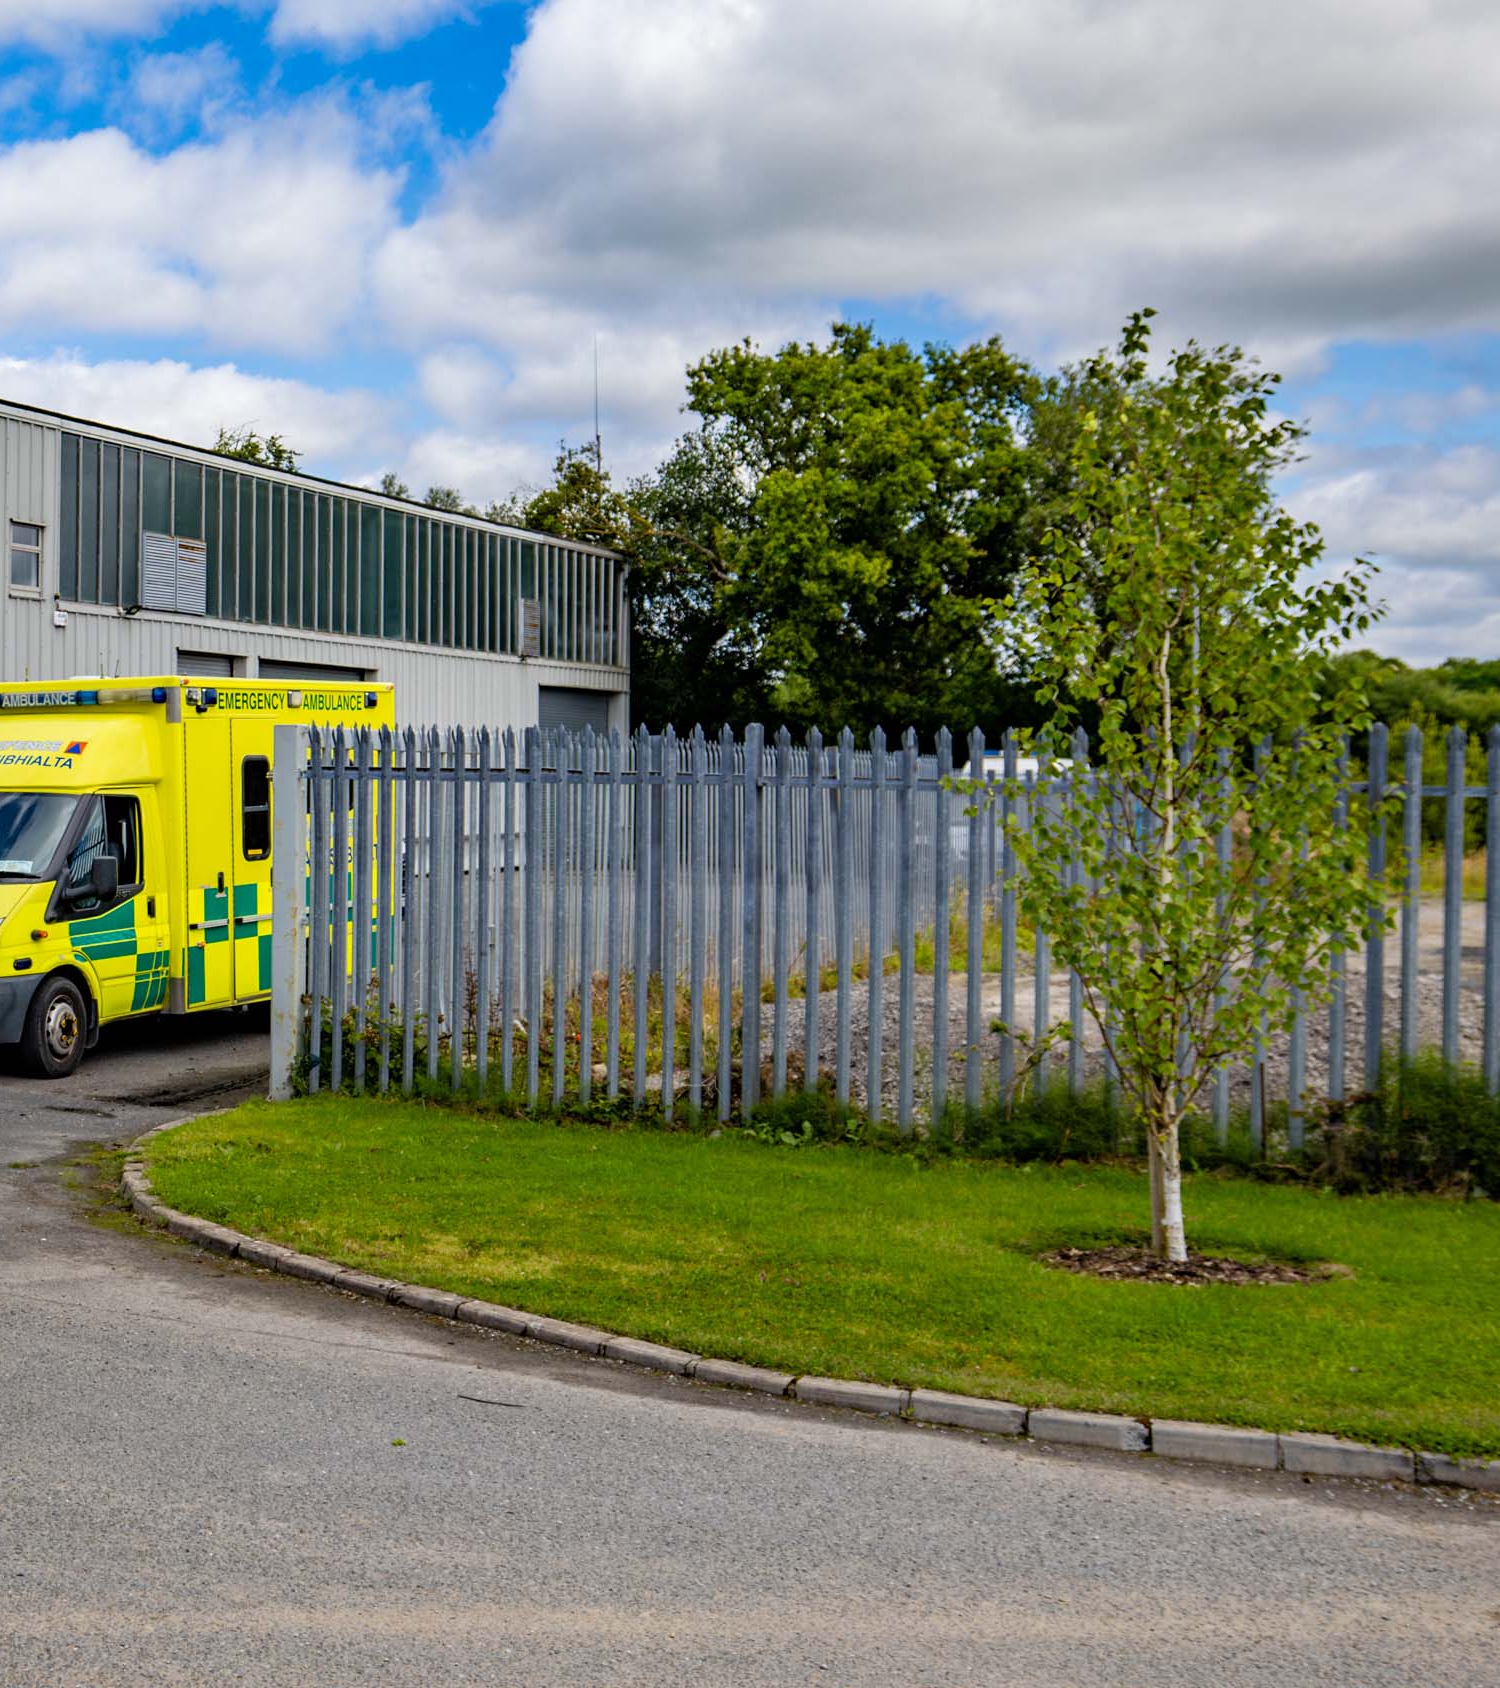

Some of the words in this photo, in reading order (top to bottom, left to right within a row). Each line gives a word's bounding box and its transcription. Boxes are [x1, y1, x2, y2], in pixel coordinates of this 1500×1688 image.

[1, 692, 76, 708] AMBULANCE
[218, 692, 285, 710] EMERGENCY
[302, 693, 362, 711] AMBULANCE
